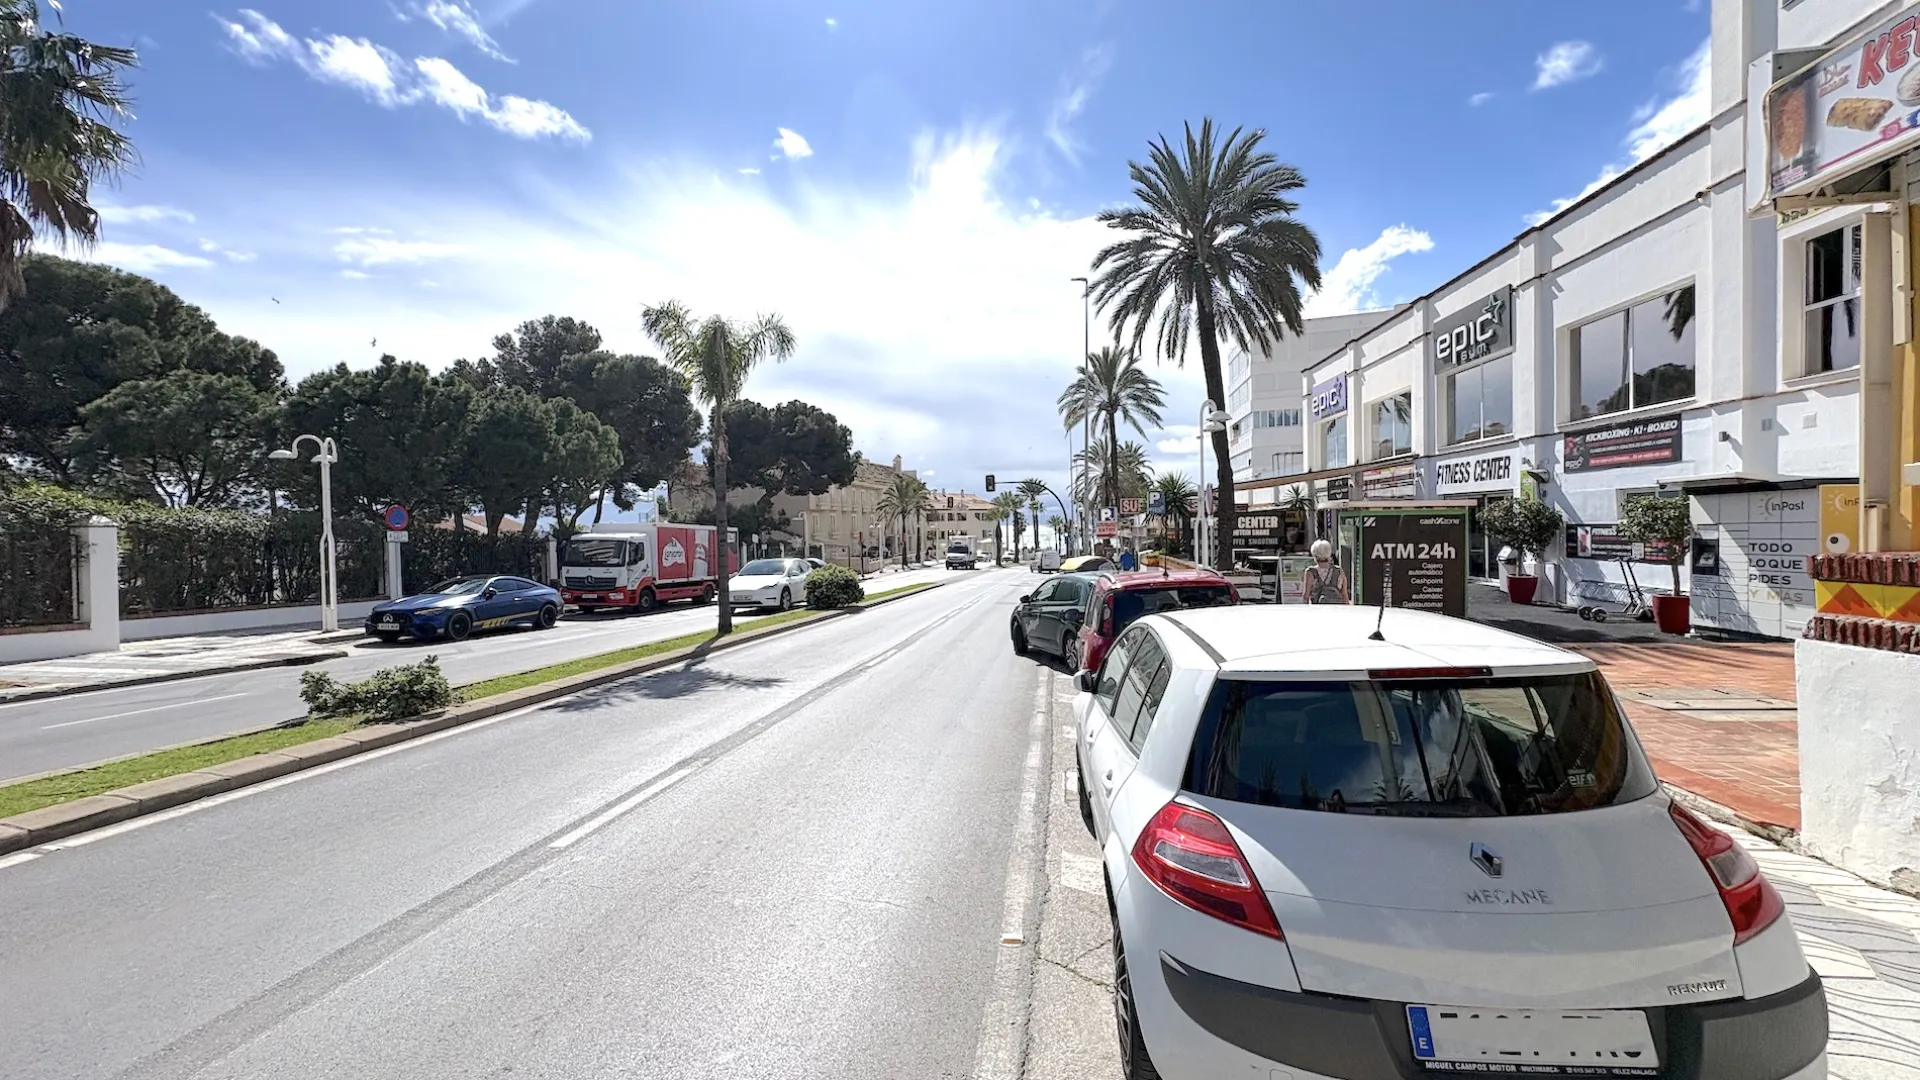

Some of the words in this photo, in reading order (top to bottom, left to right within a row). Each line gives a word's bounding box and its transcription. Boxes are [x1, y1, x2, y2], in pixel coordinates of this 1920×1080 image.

[1437, 312, 1493, 365] epic
[1312, 388, 1338, 419] epic
[1585, 426, 1630, 443] KICKBOXING
[1647, 420, 1678, 433] BOXEO
[1437, 461, 1471, 485] FITNESS
[1473, 456, 1511, 482] CENTER
[1844, 497, 1860, 506] InP
[1237, 516, 1278, 529] CENTER
[1371, 543, 1415, 559] ATM
[1418, 542, 1456, 559] 24h
[1749, 542, 1793, 553] TODO
[1422, 562, 1443, 570] Cajero
[1749, 574, 1792, 585] PIDES
[1422, 585, 1443, 593] Caixer
[1749, 589, 1759, 599] Y
[1666, 979, 1728, 996] RENAULT
[1419, 1037, 1428, 1049] E
[1425, 1061, 1454, 1070] MIGUEL
[1455, 1062, 1488, 1071] CAMPOS
[1489, 1064, 1517, 1072] MOTOR
